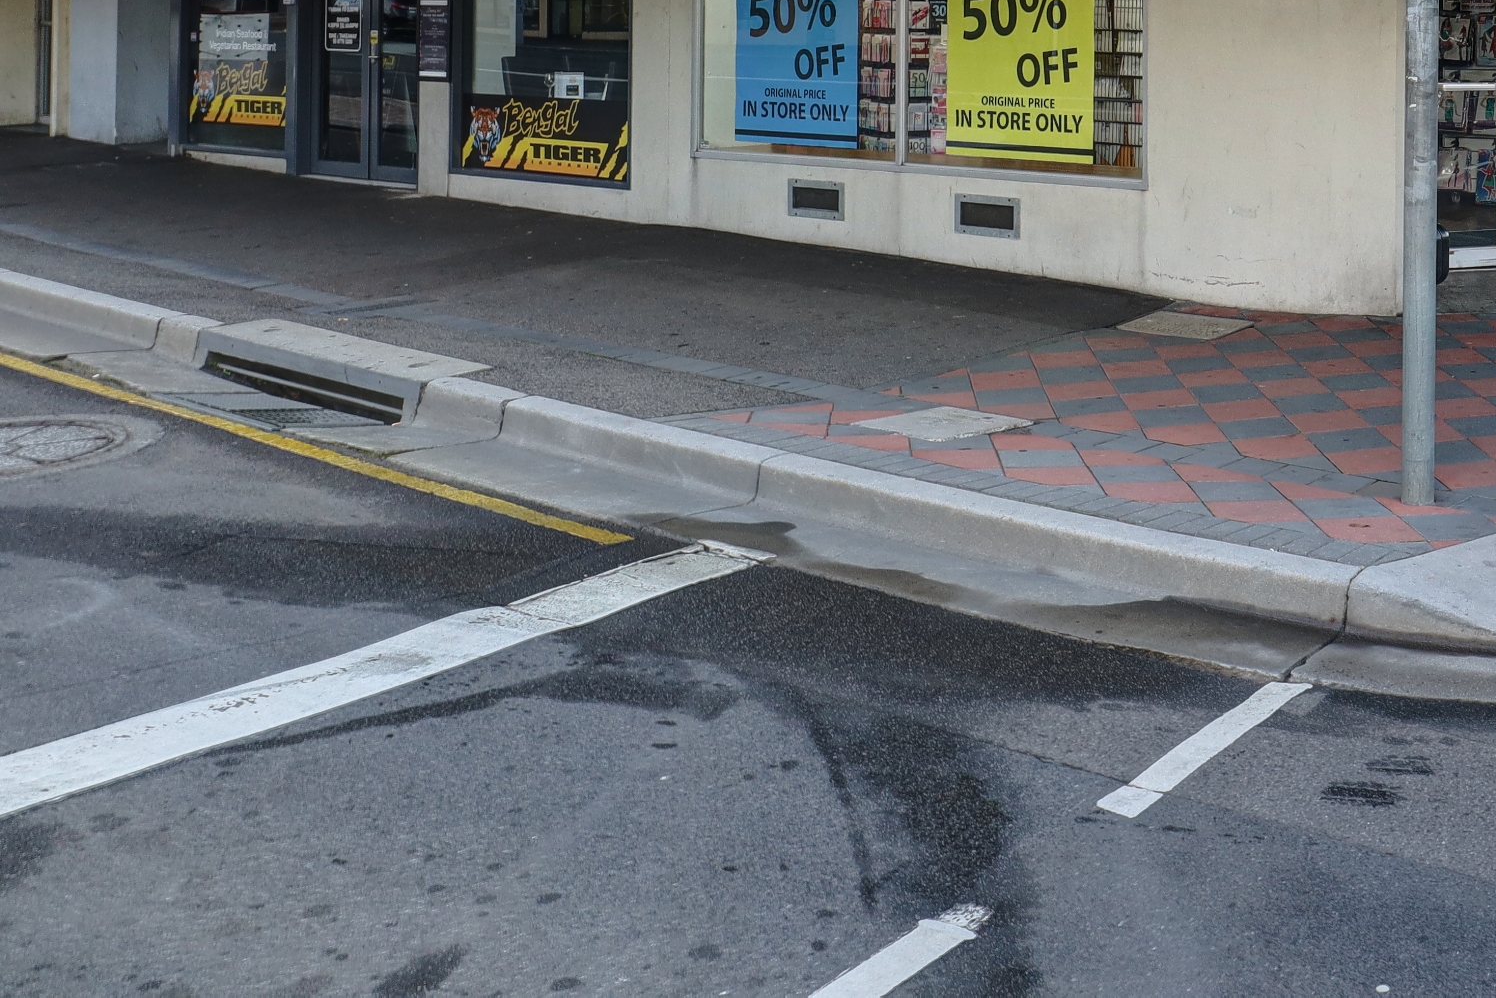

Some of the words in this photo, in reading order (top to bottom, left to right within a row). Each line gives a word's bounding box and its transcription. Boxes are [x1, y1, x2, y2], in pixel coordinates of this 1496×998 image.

[931, 4, 947, 17] 30
[216, 29, 235, 38] Indian
[237, 29, 263, 39] Seafood
[209, 41, 241, 52] Vegetarian
[242, 41, 277, 52] Restaurant
[794, 43, 846, 80] OFF
[1016, 47, 1078, 88] OFF
[215, 61, 268, 95] Bengal
[912, 72, 926, 83] 50
[764, 87, 802, 99] ORIGINAL
[803, 88, 827, 100] PRICE
[234, 99, 283, 115] TIGER
[981, 95, 1027, 108] ORIGINAL
[1028, 97, 1055, 109] PRICE
[501, 97, 580, 139] Bengal
[742, 99, 757, 118] IN
[760, 101, 806, 120] STORE
[809, 103, 850, 122] ONLY
[955, 109, 972, 128] IN
[977, 110, 1031, 131] STORE
[1035, 114, 1083, 134] ONLY
[529, 143, 601, 164] TIGER
[531, 160, 600, 170] TASMANIA
